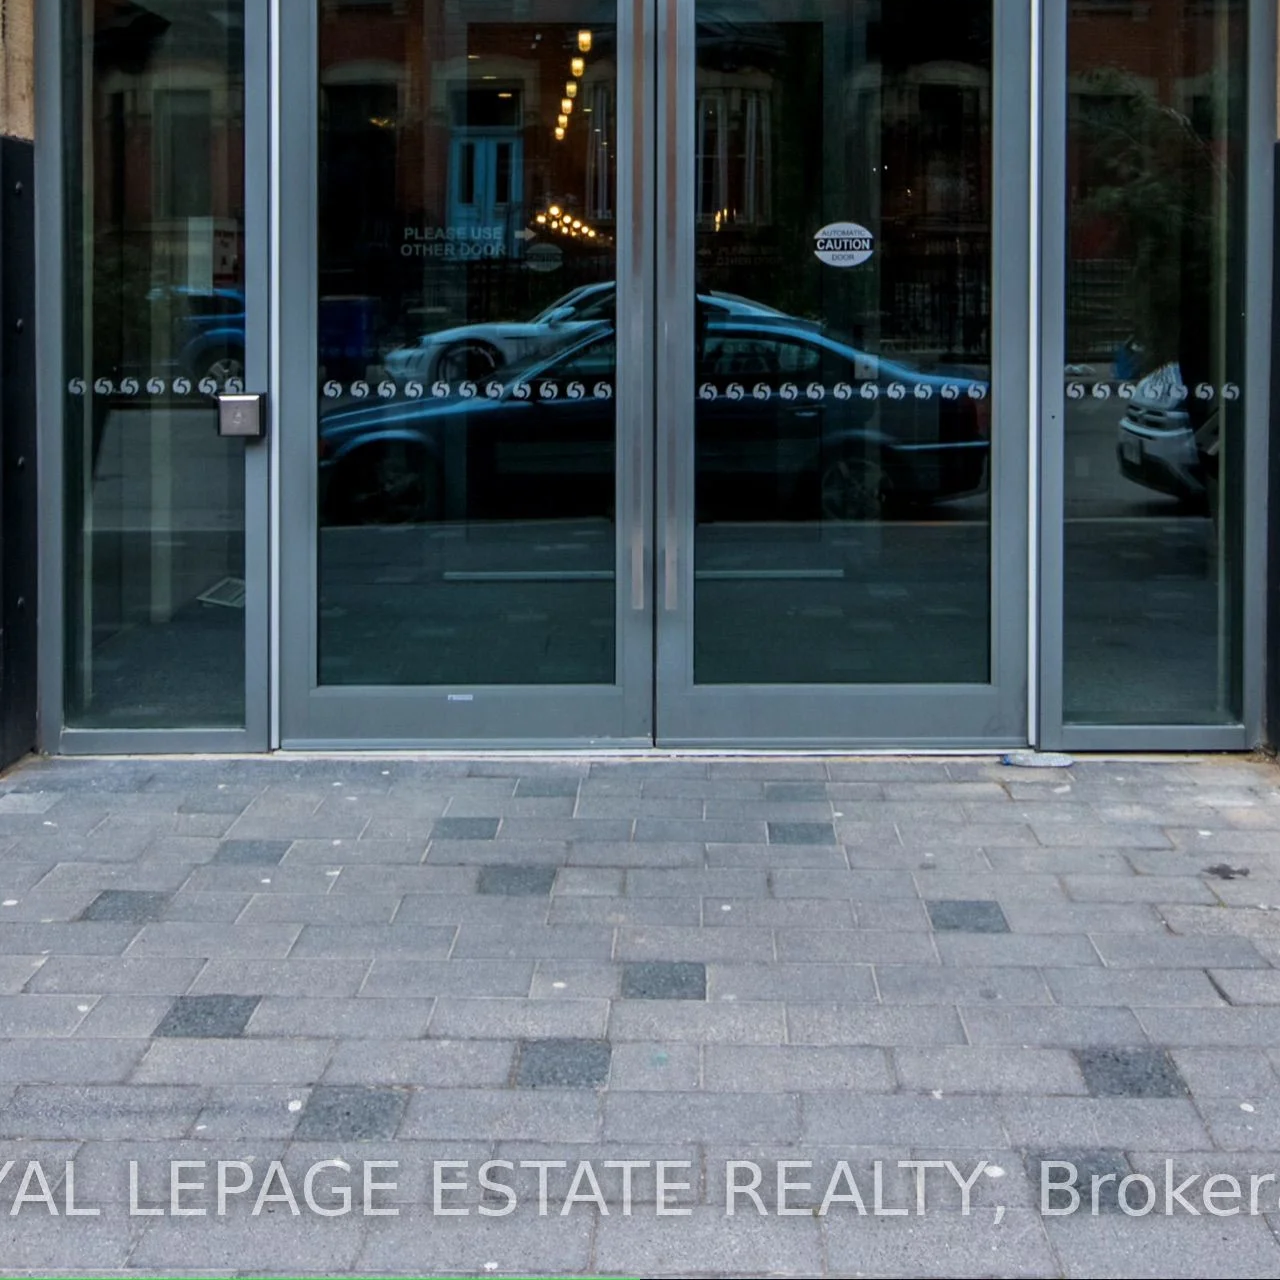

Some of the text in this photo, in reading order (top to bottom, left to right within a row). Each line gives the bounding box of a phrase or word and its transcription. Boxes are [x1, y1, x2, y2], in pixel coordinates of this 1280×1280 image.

[403, 227, 503, 240] PLEASE USE
[400, 243, 507, 257] OTHER DOOR
[816, 238, 870, 250] CAUTION
